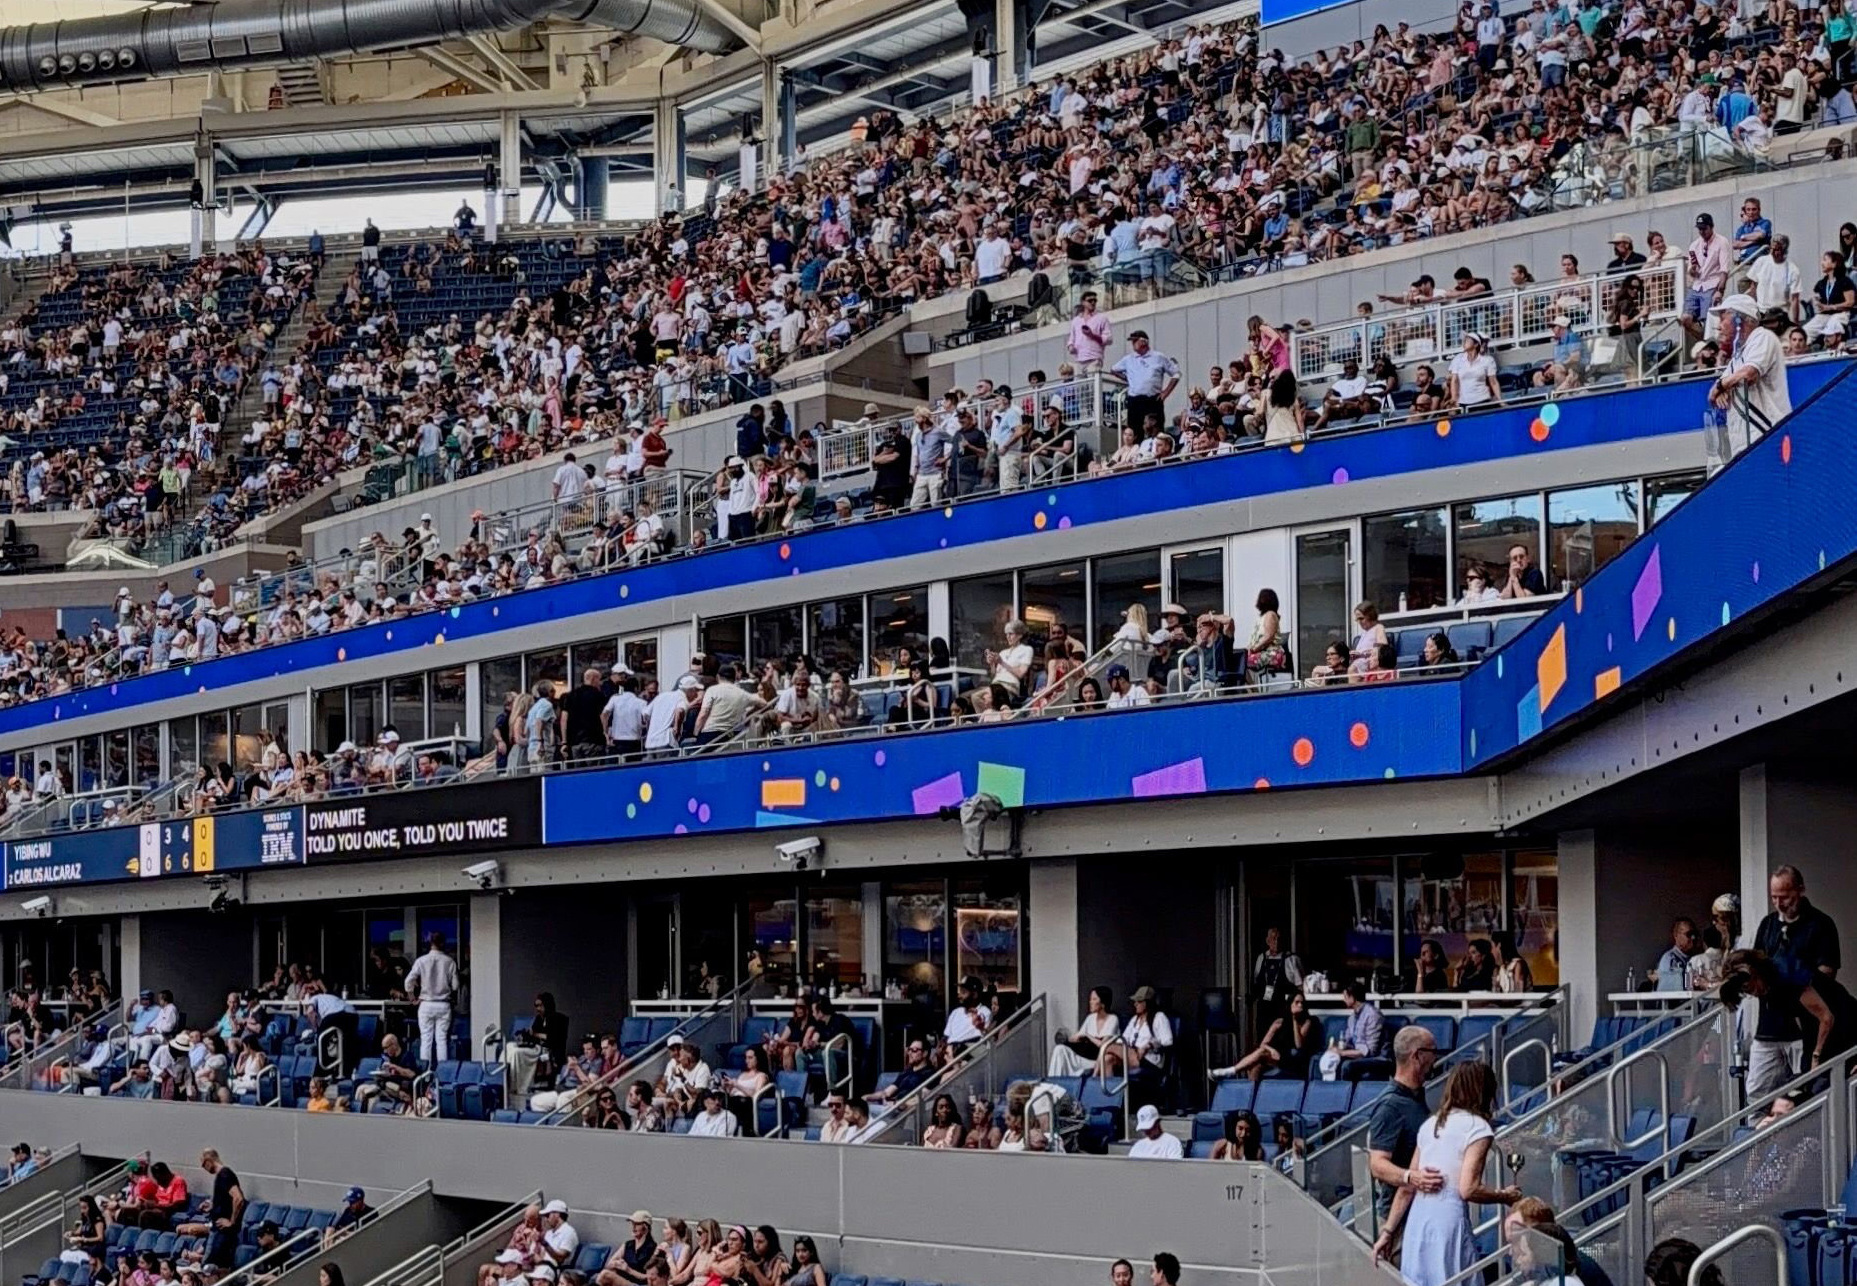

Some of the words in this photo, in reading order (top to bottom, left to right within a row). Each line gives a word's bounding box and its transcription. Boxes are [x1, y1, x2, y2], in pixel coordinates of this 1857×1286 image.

[310, 808, 365, 830] DYNAMITE
[307, 835, 335, 853] TOLD
[338, 833, 361, 850] YOU
[364, 829, 400, 849] ONCE,
[404, 825, 435, 844] TOLD
[438, 822, 463, 841] YOU
[467, 818, 507, 839] TWICE
[14, 867, 43, 885] CARLOS
[43, 863, 81, 883] ALCARAZ
[1225, 1185, 1244, 1201] 117
